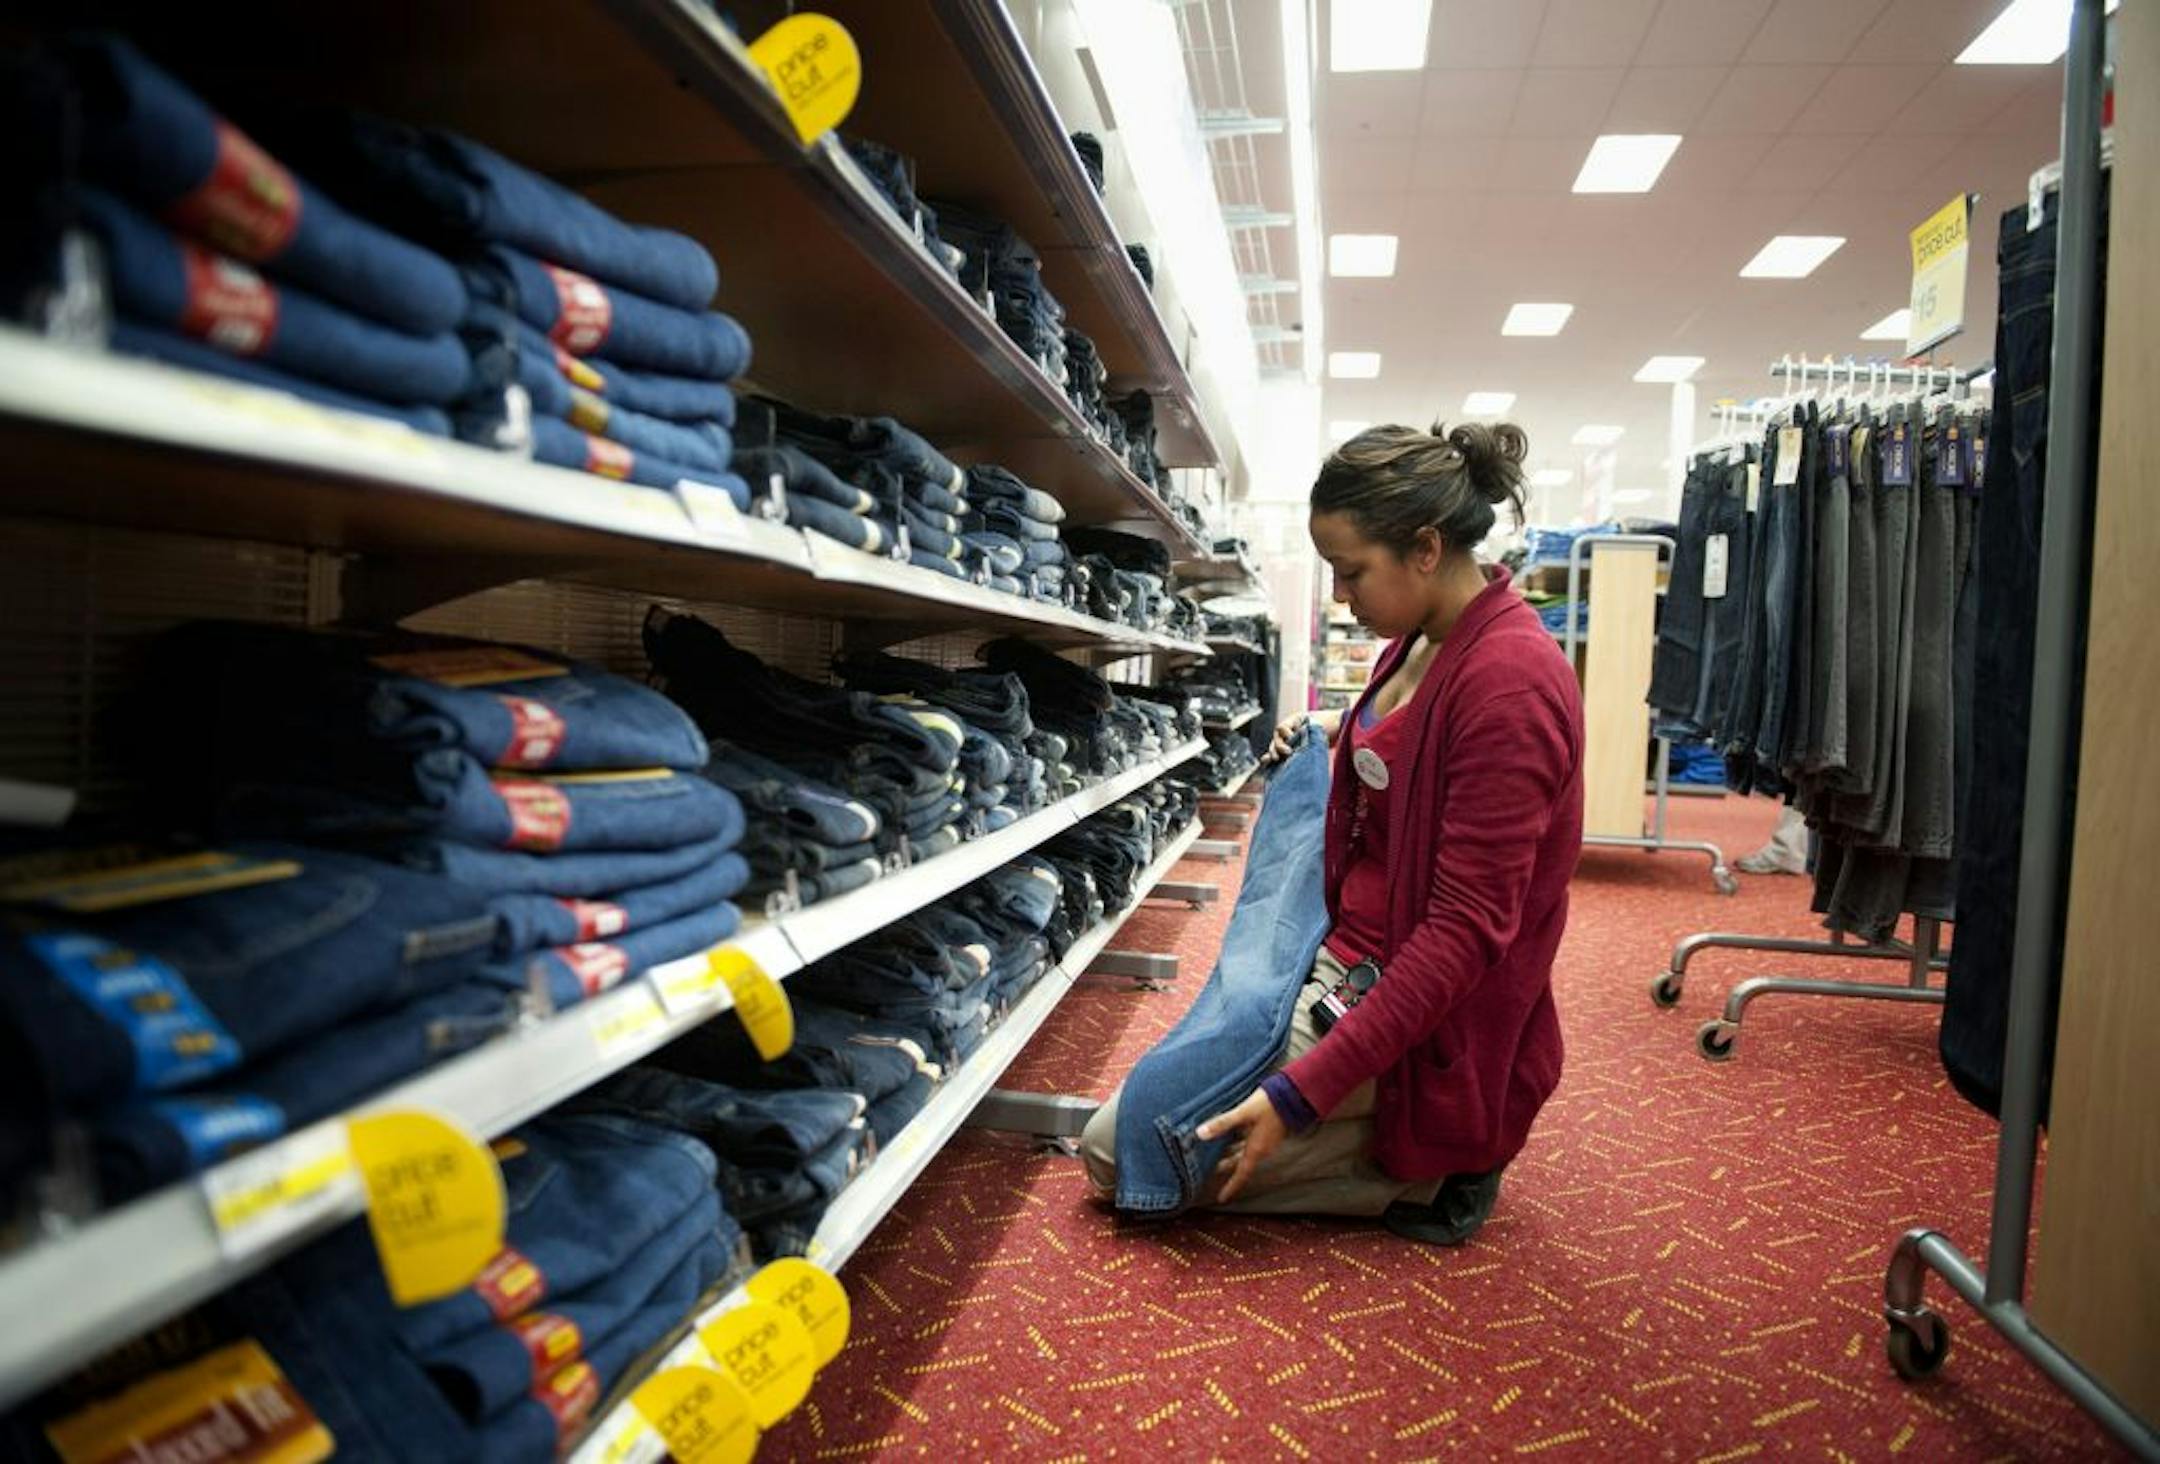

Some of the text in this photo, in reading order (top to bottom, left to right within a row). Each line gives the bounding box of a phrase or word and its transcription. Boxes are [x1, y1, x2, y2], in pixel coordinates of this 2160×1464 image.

[776, 32, 829, 84] price
[787, 64, 823, 100] cut
[1917, 232, 1943, 266] price
[1944, 214, 1963, 246] cut
[371, 1151, 459, 1200] price
[379, 1190, 438, 1231] cut
[777, 1275, 814, 1309] rice
[724, 1321, 779, 1370] price
[738, 1351, 776, 1387] cut
[658, 1384, 713, 1437] price
[672, 1416, 713, 1456] cut
